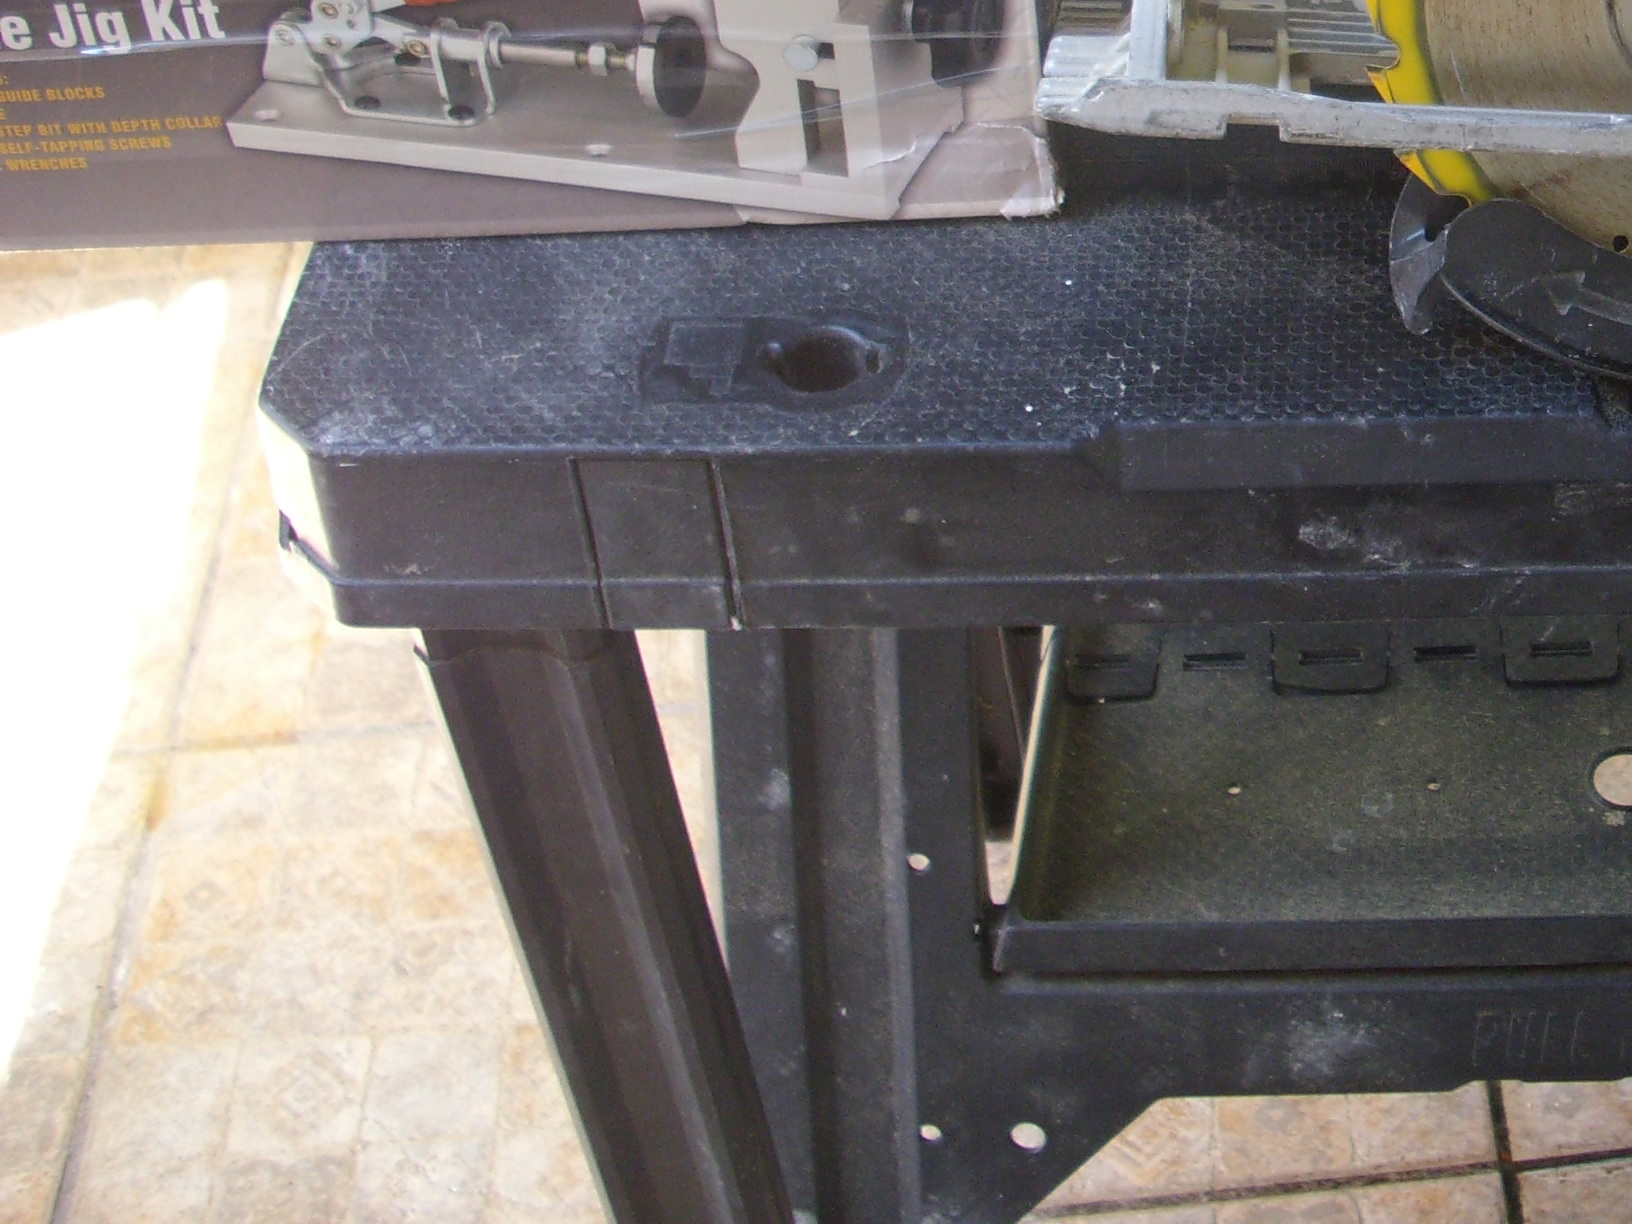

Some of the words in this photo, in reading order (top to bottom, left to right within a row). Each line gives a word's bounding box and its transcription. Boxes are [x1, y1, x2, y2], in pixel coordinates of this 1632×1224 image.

[49, 0, 132, 54] Jig
[0, 88, 42, 103] GUIDE
[46, 86, 106, 101] BLOCKS
[38, 123, 62, 137] BIT
[68, 121, 107, 135] WITH
[111, 118, 161, 133] DEPTH
[165, 115, 223, 130] COLLAR
[0, 139, 105, 155] SELF-TAPPING
[109, 136, 173, 151] SCREWS
[6, 156, 89, 172] WRENCHES
